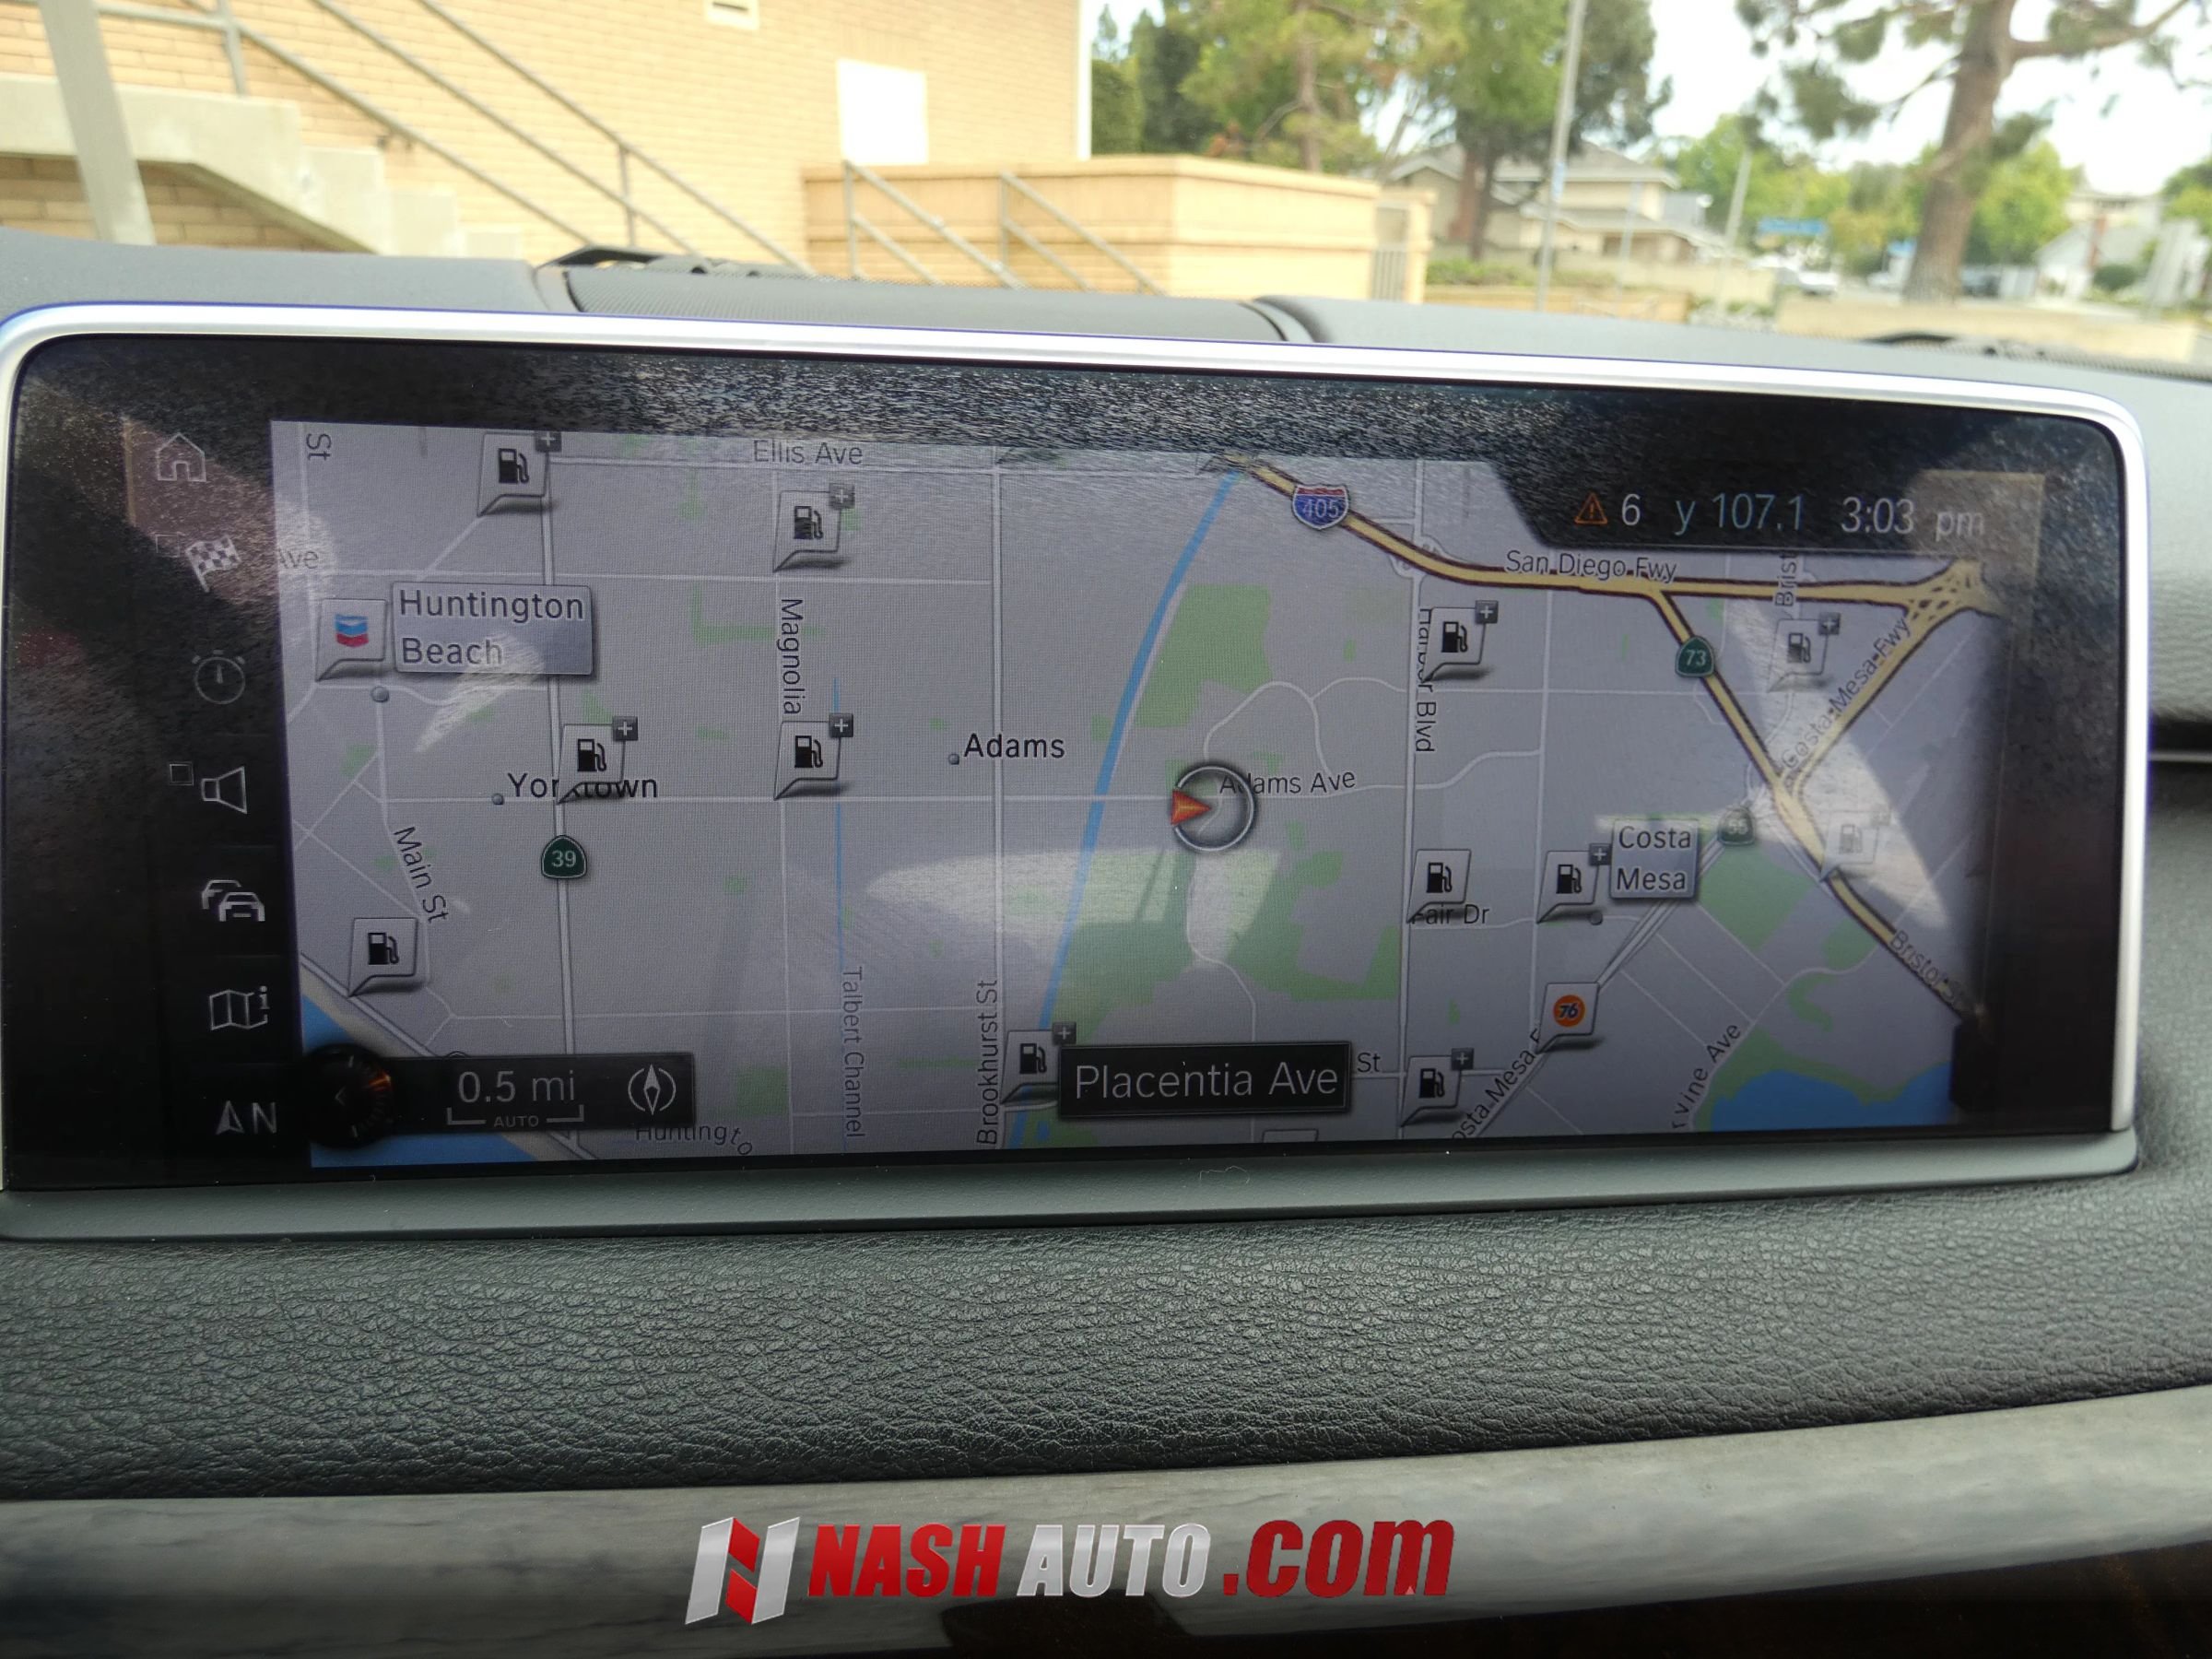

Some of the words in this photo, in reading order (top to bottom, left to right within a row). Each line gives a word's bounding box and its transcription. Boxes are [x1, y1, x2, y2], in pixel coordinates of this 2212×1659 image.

[305, 433, 332, 462] St
[753, 439, 806, 464] Ellis
[814, 441, 864, 465] Ave
[1302, 498, 1339, 519] 405
[1621, 493, 1641, 527] 6
[1674, 500, 1697, 536] y
[1712, 491, 1806, 532] 107.1
[1841, 496, 1915, 535] 3:03
[1936, 511, 1985, 543] pm
[1506, 549, 1550, 573] San
[1559, 552, 1628, 582] Diego
[1635, 556, 1677, 584] Fwy
[399, 589, 584, 624] Huntington
[401, 637, 503, 665] Beach
[775, 598, 806, 715] Magnolia
[1686, 648, 1706, 667] 73
[1781, 713, 1838, 770] Costa
[1828, 647, 1880, 717] Mesa
[1872, 617, 1912, 661] Fwy
[1415, 701, 1437, 752] Blvd
[963, 732, 1065, 759] Adams
[1218, 772, 1302, 795] Adams
[1310, 771, 1356, 794] Ave
[1618, 825, 1692, 850] Costa
[393, 826, 432, 890] Main
[421, 893, 450, 924] St
[551, 850, 577, 869] 39
[1617, 867, 1687, 891] Mesa
[1463, 903, 1490, 924] Dr
[842, 965, 863, 1044] Talbert
[975, 979, 998, 1005] St
[1557, 1002, 1579, 1020] 76
[1706, 1024, 1741, 1064] Ave
[976, 1011, 999, 1145] Brookhurst
[1357, 1052, 1382, 1073] St
[1484, 1049, 1536, 1103] Mesa
[458, 1070, 516, 1103] 0.5
[532, 1069, 575, 1101] mi
[843, 1051, 866, 1138] Channel
[1077, 1063, 1253, 1100] Placentia
[1267, 1061, 1338, 1096] Ave
[253, 1100, 277, 1134] N
[493, 1114, 540, 1128] AUTO
